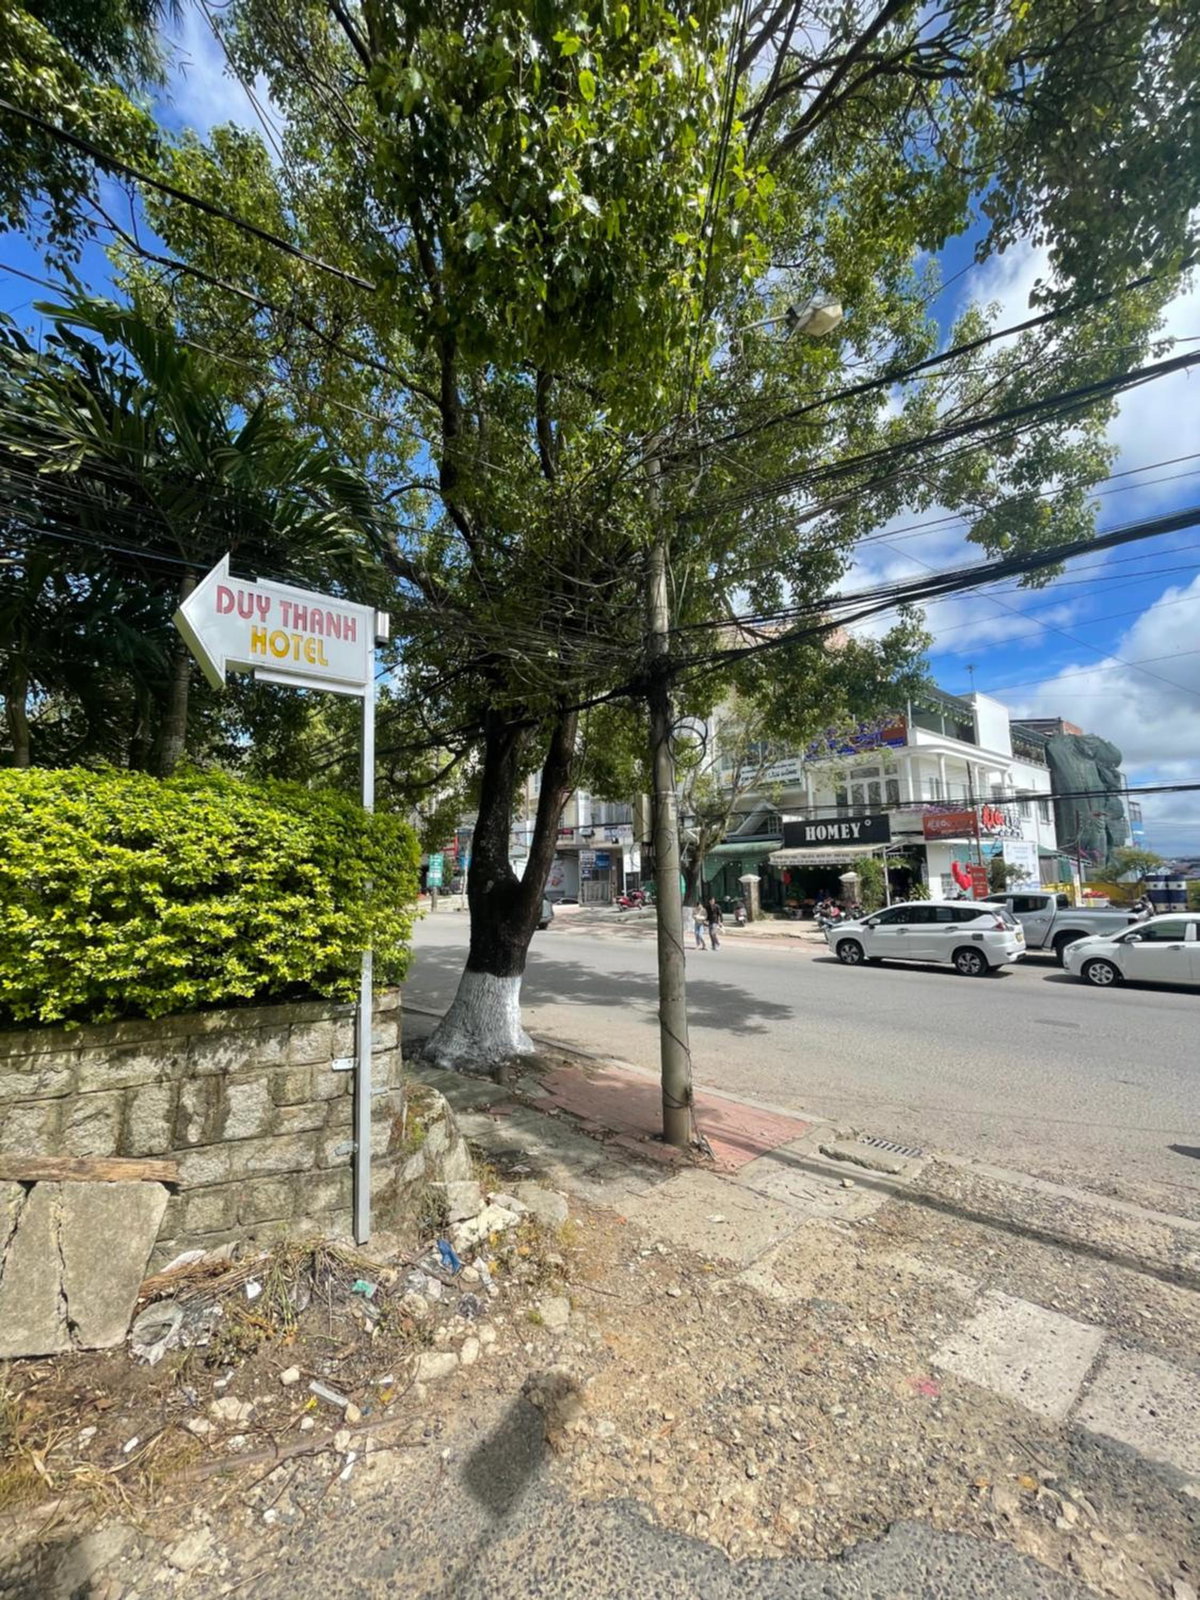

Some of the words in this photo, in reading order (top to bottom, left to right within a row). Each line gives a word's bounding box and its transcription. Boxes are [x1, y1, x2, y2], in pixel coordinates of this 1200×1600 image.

[216, 585, 271, 622] DUY
[279, 600, 357, 642] THANH
[251, 625, 329, 666] HOTEL
[805, 822, 861, 841] HOMEY
